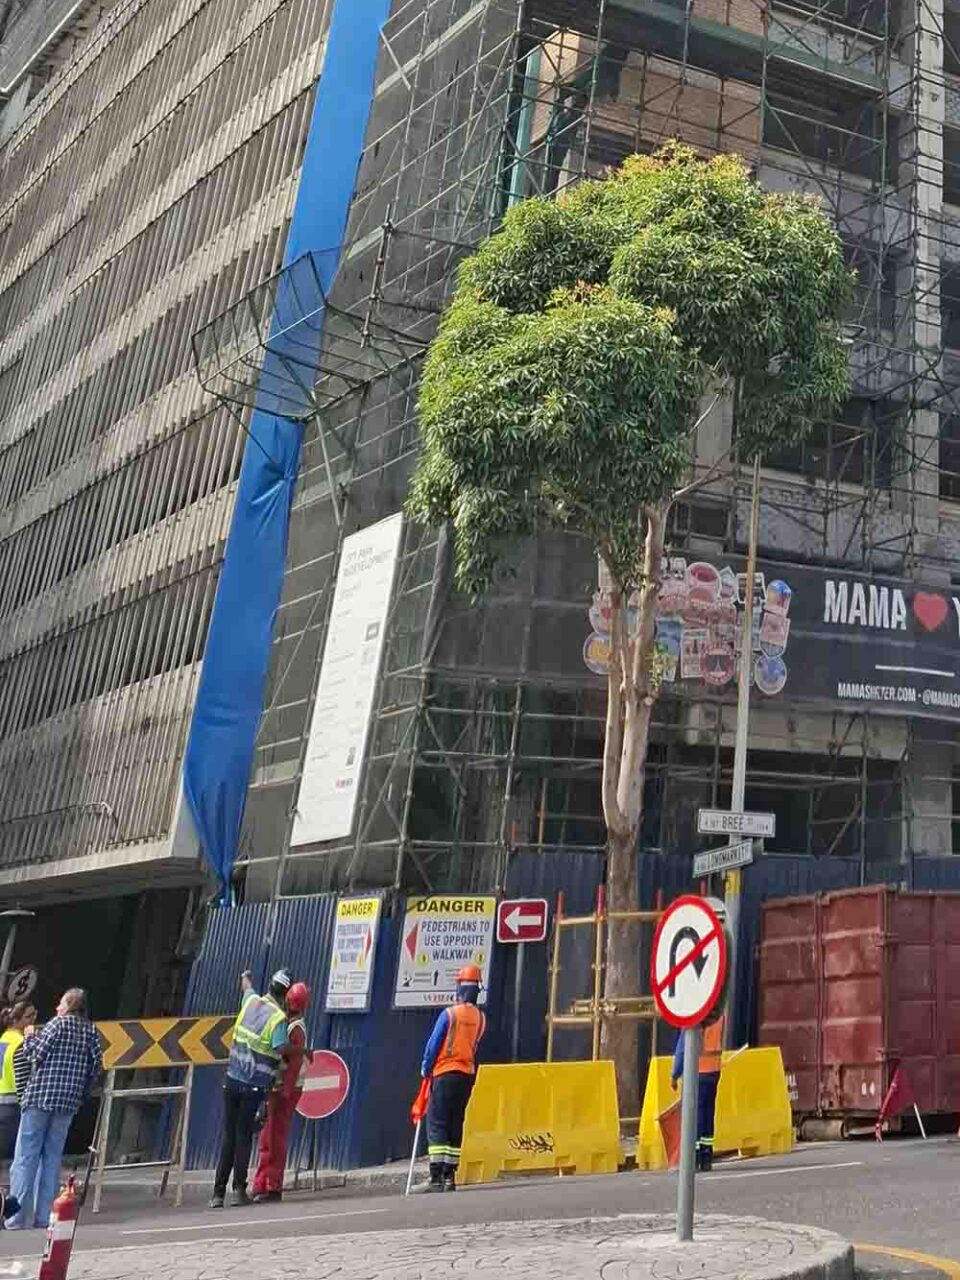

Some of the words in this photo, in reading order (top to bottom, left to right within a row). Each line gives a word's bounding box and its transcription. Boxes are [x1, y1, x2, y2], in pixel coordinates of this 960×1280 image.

[823, 580, 907, 631] MAMA
[722, 815, 744, 831] BREE
[341, 902, 373, 917] DANGER
[416, 900, 485, 912] DANGER
[421, 920, 477, 933] PEDESTRIANS
[480, 921, 490, 932] TO
[424, 935, 441, 946] USE
[443, 934, 485, 946] OPPOSITE
[432, 948, 474, 961] WALKWAY
